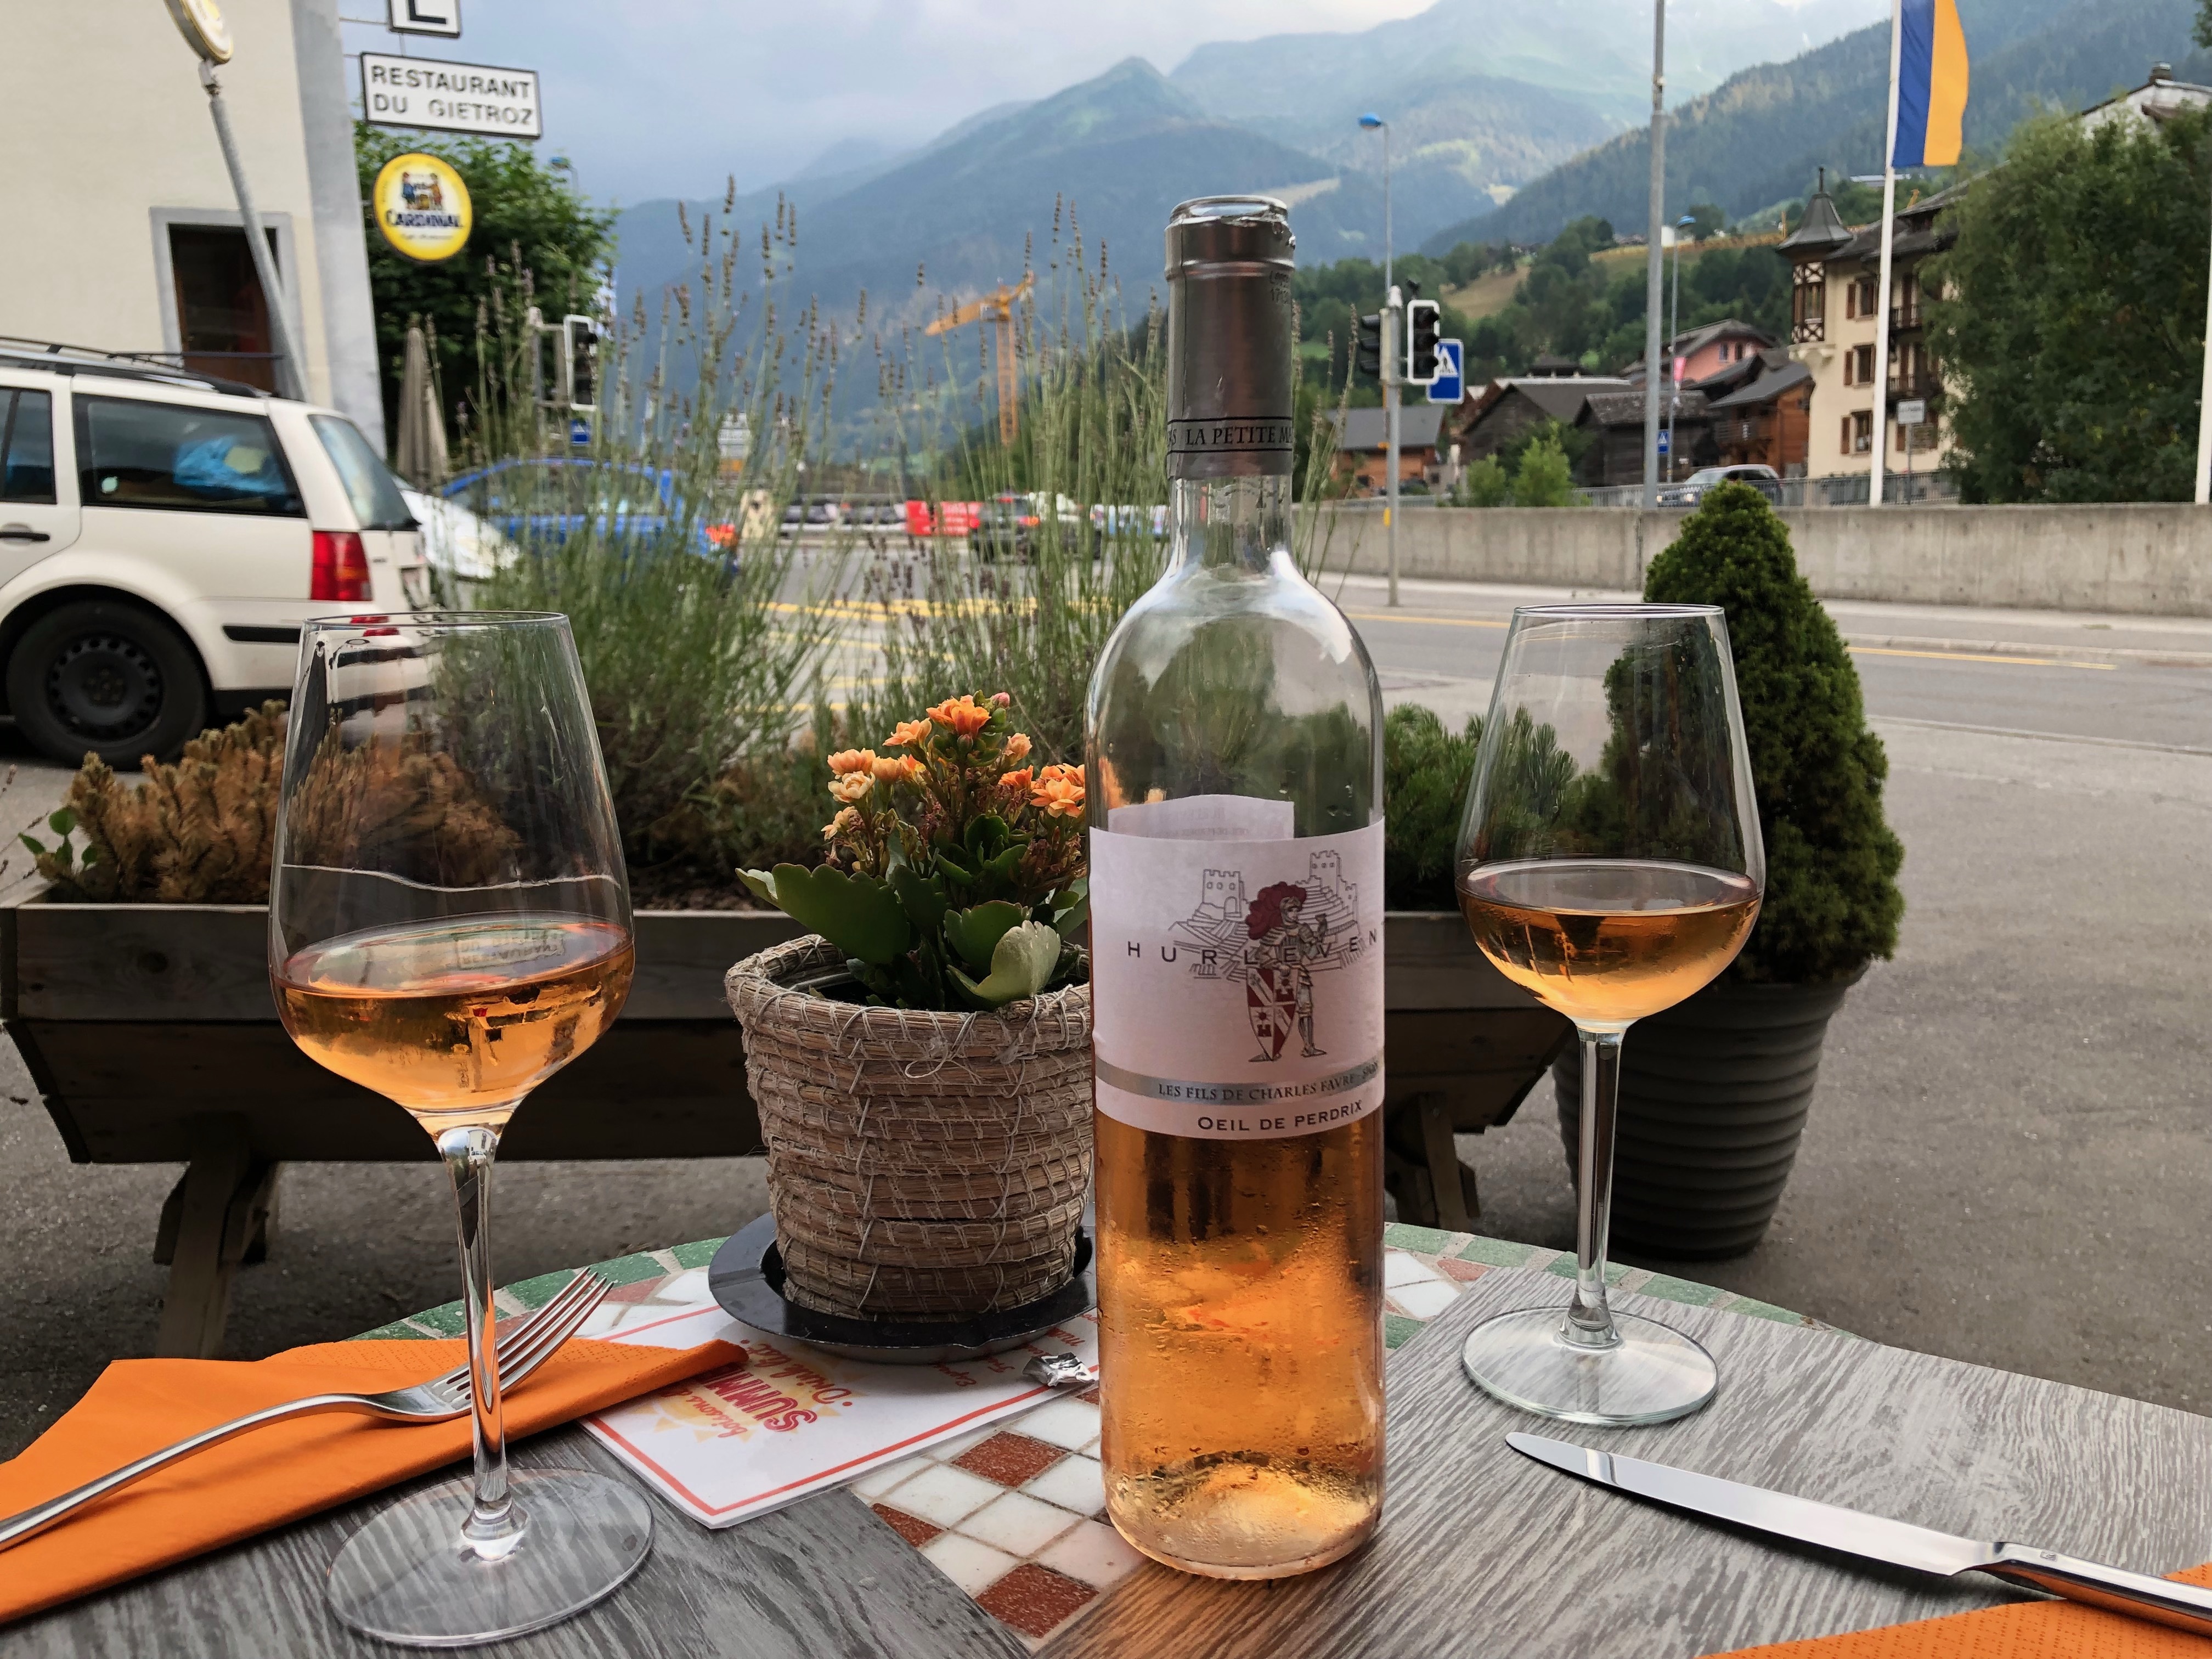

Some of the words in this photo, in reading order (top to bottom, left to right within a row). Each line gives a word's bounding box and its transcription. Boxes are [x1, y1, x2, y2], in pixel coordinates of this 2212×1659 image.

[371, 65, 529, 99] RESTAURANT
[374, 92, 407, 114] DU
[428, 99, 533, 125] GIETROZ
[1186, 428, 1206, 445] LA
[1211, 426, 1276, 445] PETITE
[1159, 1083, 1181, 1097] LES
[1186, 1086, 1217, 1101] FILS
[1222, 1088, 1244, 1101] DE
[1248, 1082, 1317, 1101] CHARLES
[1321, 1073, 1355, 1092] FAVRE
[1198, 1116, 1250, 1131] OEIL
[1260, 1118, 1285, 1130] DE
[1294, 1099, 1363, 1127] PERDRIX
